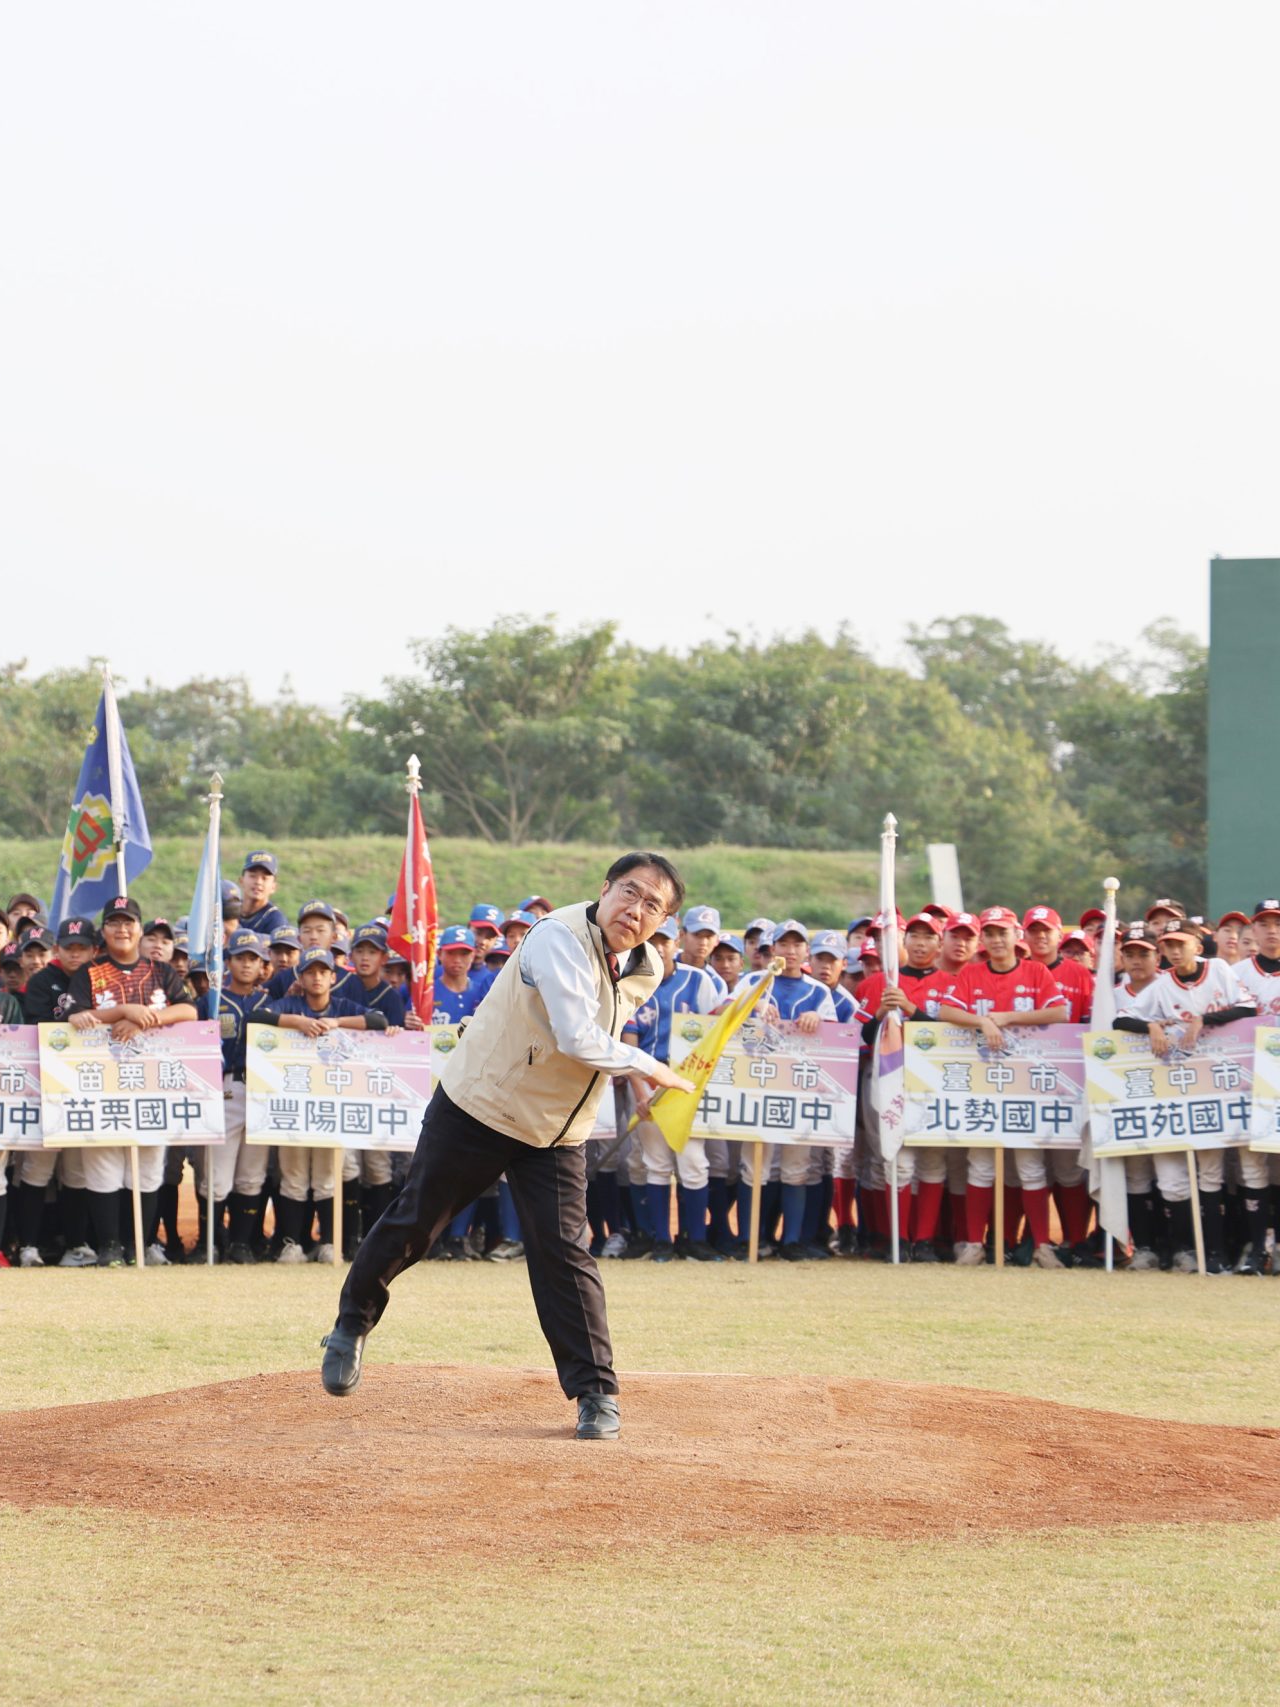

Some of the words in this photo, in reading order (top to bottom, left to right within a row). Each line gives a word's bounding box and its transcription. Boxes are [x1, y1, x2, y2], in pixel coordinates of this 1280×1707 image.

[486, 909, 499, 920] S
[455, 929, 467, 941] S
[77, 1060, 188, 1092] 苗栗縣
[283, 1064, 397, 1096] 臺中市
[708, 1055, 821, 1090] 臺中市
[942, 1062, 1059, 1093] 臺中市
[1125, 1062, 1243, 1099] 臺中市
[64, 1096, 202, 1132] 苗栗國中
[269, 1099, 408, 1136] 豐陽國中
[695, 1091, 833, 1131] 中山國中
[926, 1097, 1073, 1135] 北勢國中
[1111, 1096, 1252, 1141] 西苑國中
